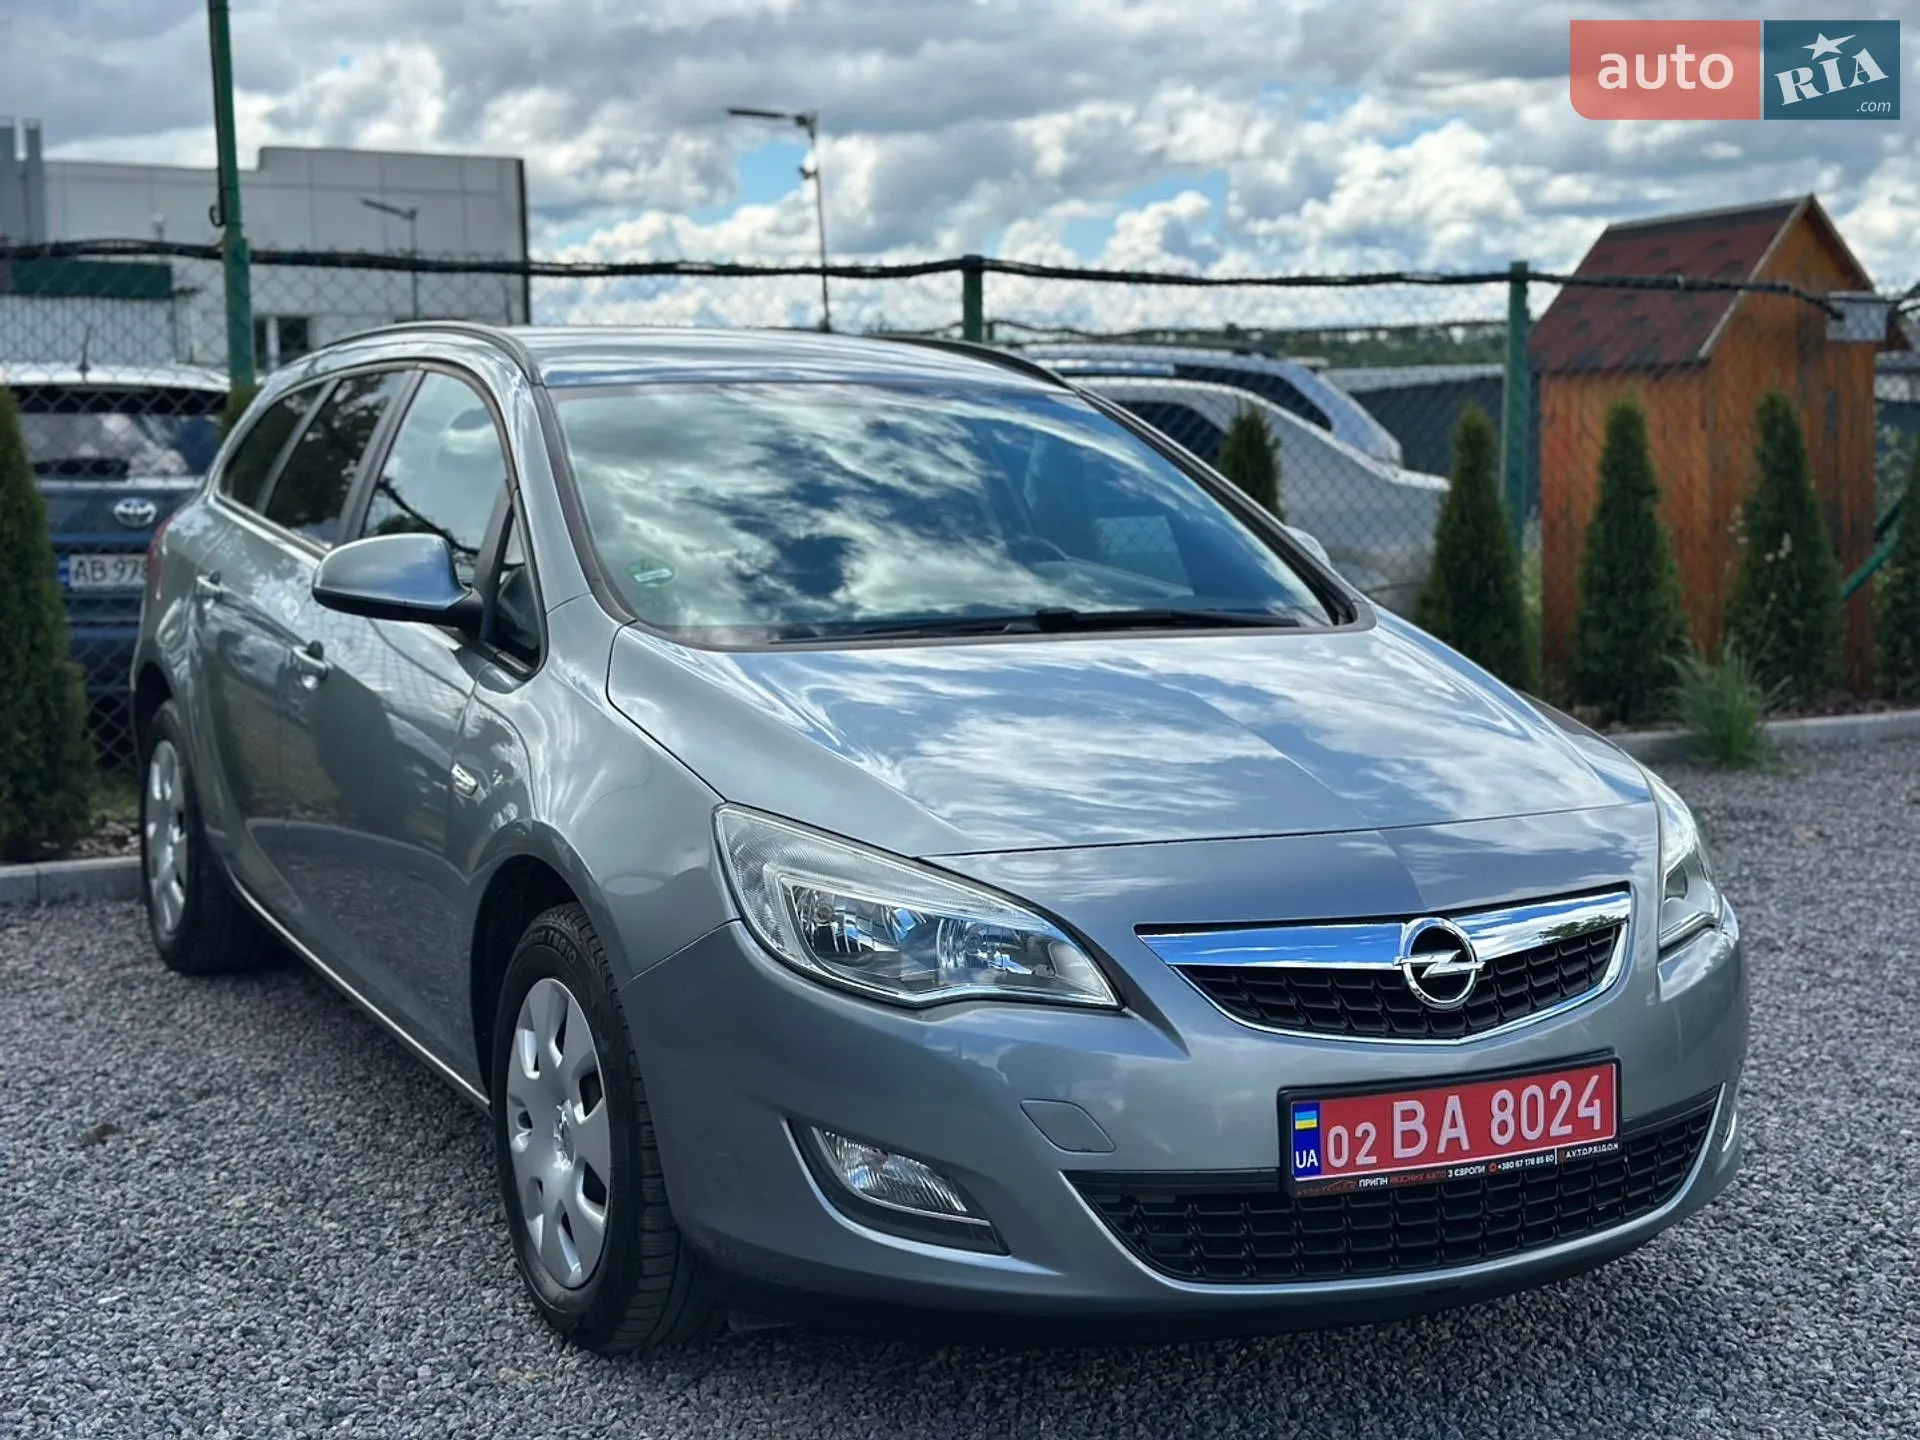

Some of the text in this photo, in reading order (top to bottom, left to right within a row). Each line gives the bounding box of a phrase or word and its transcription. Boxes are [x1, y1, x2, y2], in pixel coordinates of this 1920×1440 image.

[74, 559, 107, 582] AB
[1327, 1075, 1601, 1168] 02 BA 8024
[1295, 1149, 1319, 1169] UA
